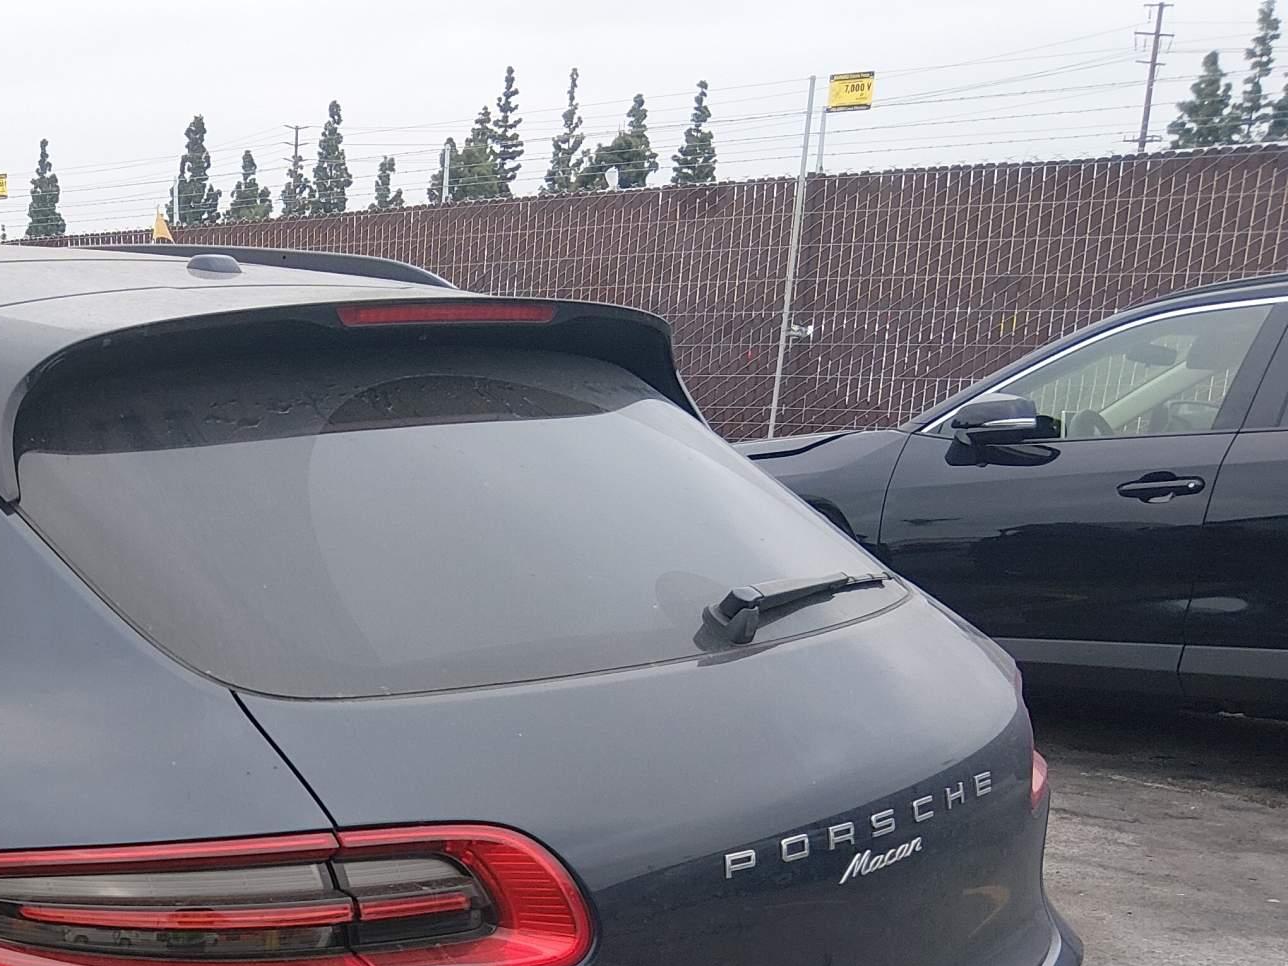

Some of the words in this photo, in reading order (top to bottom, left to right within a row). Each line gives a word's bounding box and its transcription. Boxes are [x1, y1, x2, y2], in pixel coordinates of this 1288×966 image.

[844, 83, 865, 94] 7,000
[724, 771, 992, 879] PORSCHE
[838, 836, 922, 885] Macan
